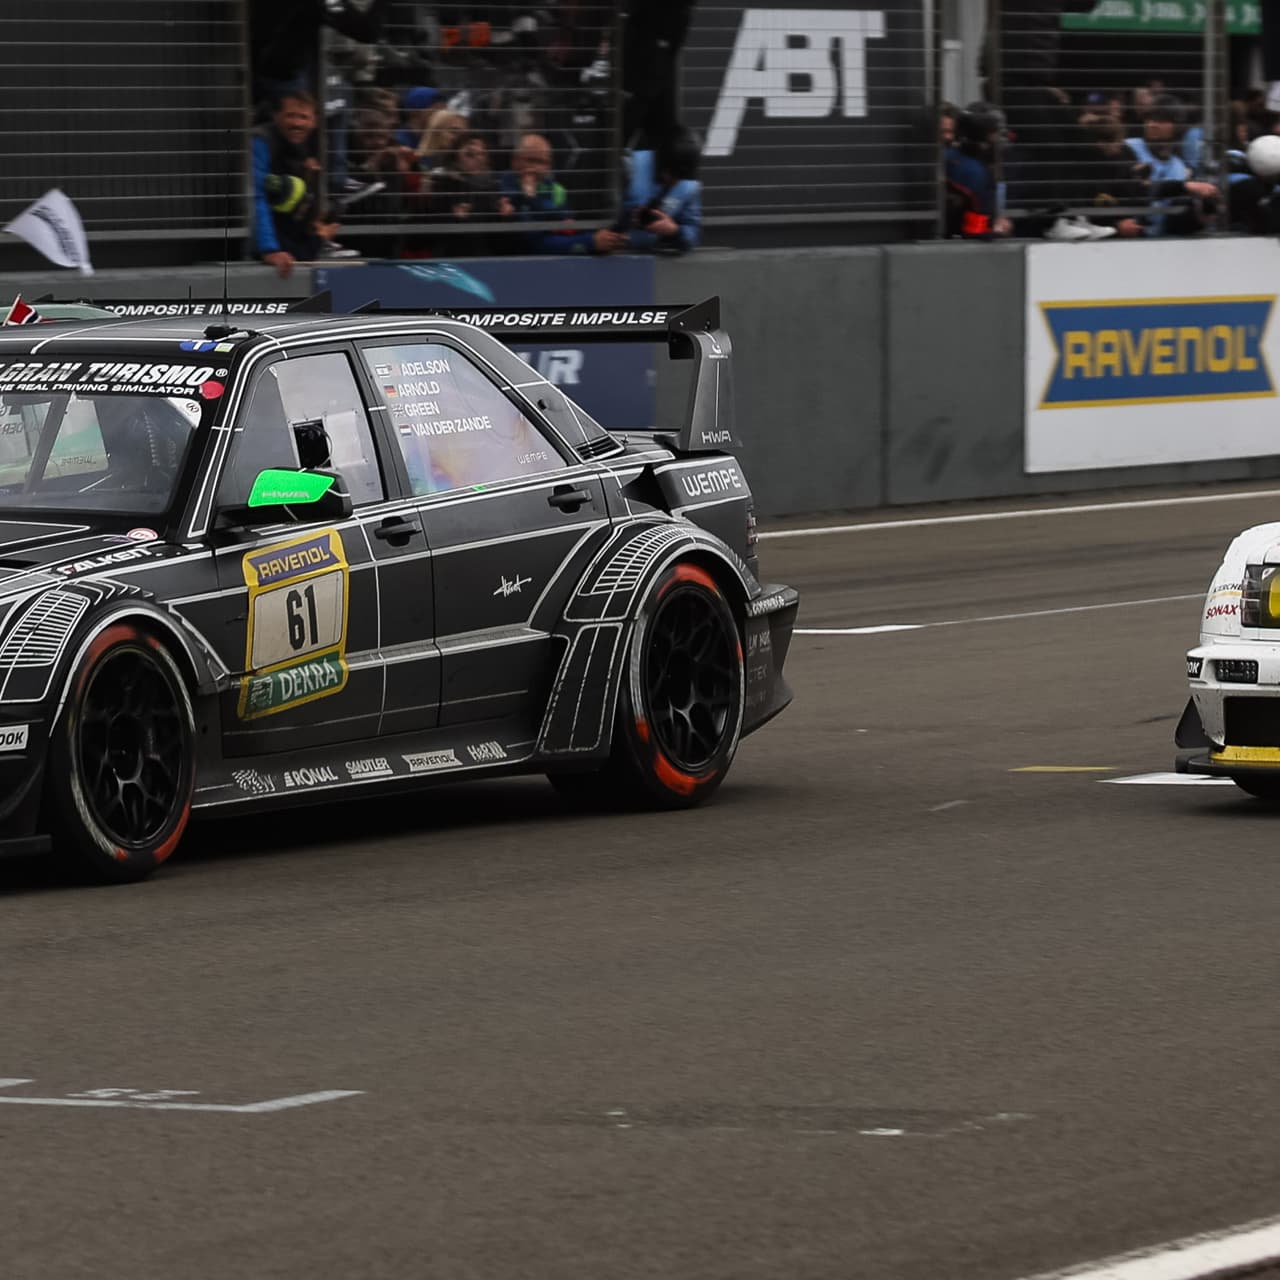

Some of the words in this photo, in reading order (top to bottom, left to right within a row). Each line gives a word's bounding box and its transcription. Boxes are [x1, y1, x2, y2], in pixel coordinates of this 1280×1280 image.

[702, 8, 886, 156] ABT
[209, 303, 288, 315] IMPULSE
[570, 311, 669, 326] IMPULSE
[1063, 325, 1257, 379] RAVENOL
[77, 363, 214, 386] TURISMO
[401, 361, 450, 376] ADELSON
[16, 384, 50, 392] REAL
[53, 383, 108, 392] DRIVING
[111, 384, 195, 395] SIMULATOR
[398, 383, 440, 398] ARNOLD
[404, 402, 440, 418] GREEN
[413, 422, 434, 438] VAN
[434, 420, 457, 436] DER
[457, 416, 491, 434] ZANDE
[701, 431, 732, 445] HWA
[517, 452, 548, 465] WEMPE
[683, 468, 742, 497] WEMPE
[57, 548, 152, 575] FALKEN
[258, 545, 330, 579] RAVENOL
[286, 584, 318, 650] 61
[1206, 605, 1239, 620] SONAX
[278, 659, 339, 701] DEKRA
[294, 765, 339, 787] RONAL
